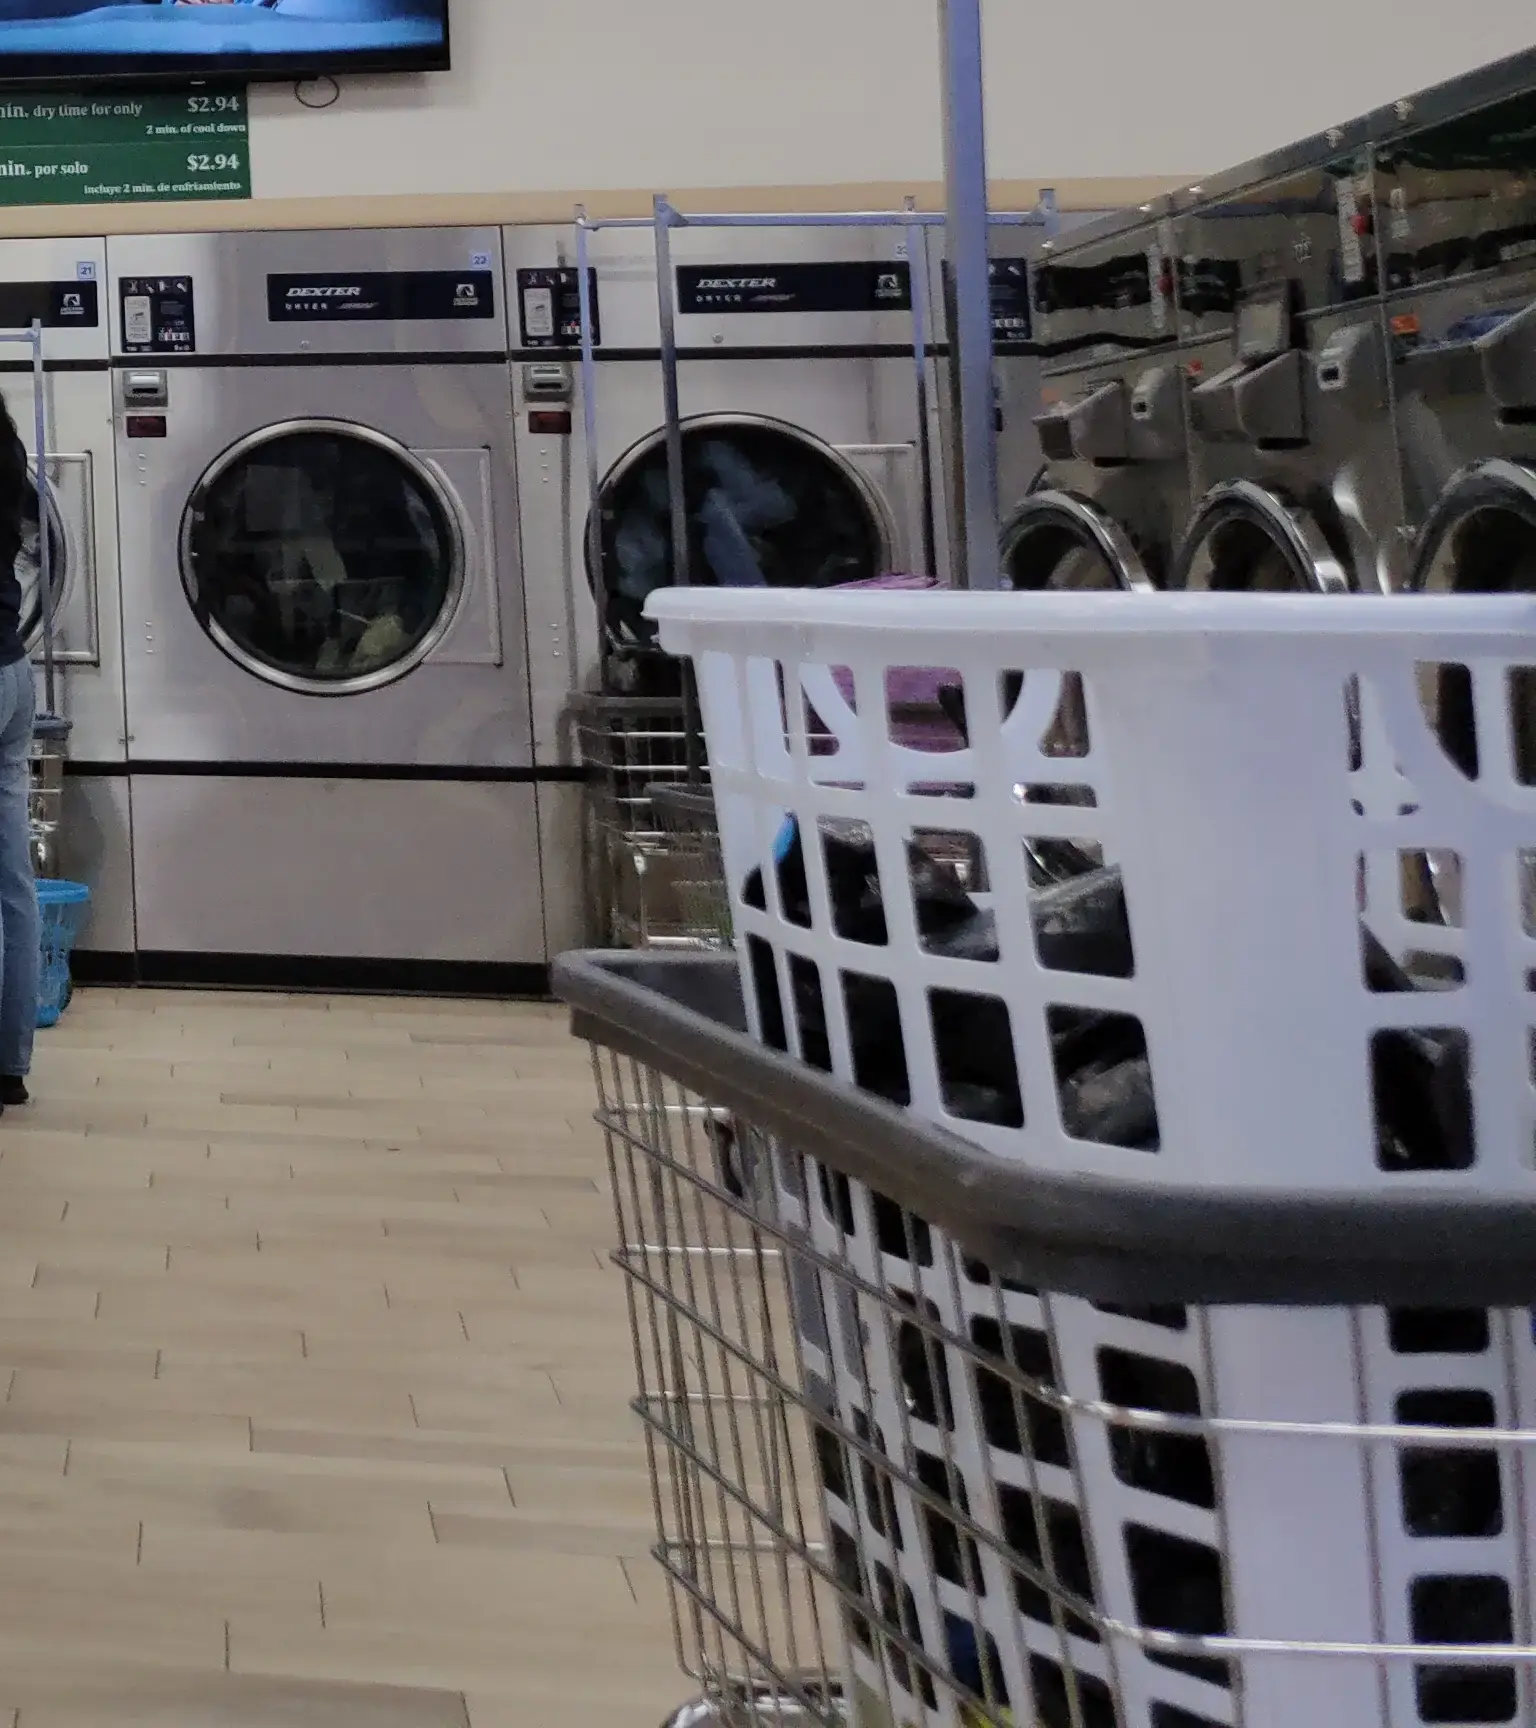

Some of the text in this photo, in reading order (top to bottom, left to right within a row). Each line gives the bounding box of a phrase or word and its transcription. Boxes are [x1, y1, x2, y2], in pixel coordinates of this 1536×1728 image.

[33, 104, 56, 120] dry
[59, 103, 88, 117] time
[91, 103, 112, 116] for
[113, 101, 143, 118] only
[187, 96, 240, 113] $2.94
[146, 122, 246, 135] 2 min. of cool down
[187, 153, 240, 172] $2.94
[34, 164, 58, 179] por
[61, 161, 89, 174] solo
[83, 180, 243, 196] incluye 2 min. de enfriamiento
[473, 255, 487, 265] 22
[80, 266, 93, 275] 21
[696, 277, 777, 289] DEXTER
[285, 286, 362, 297] DEXTER
